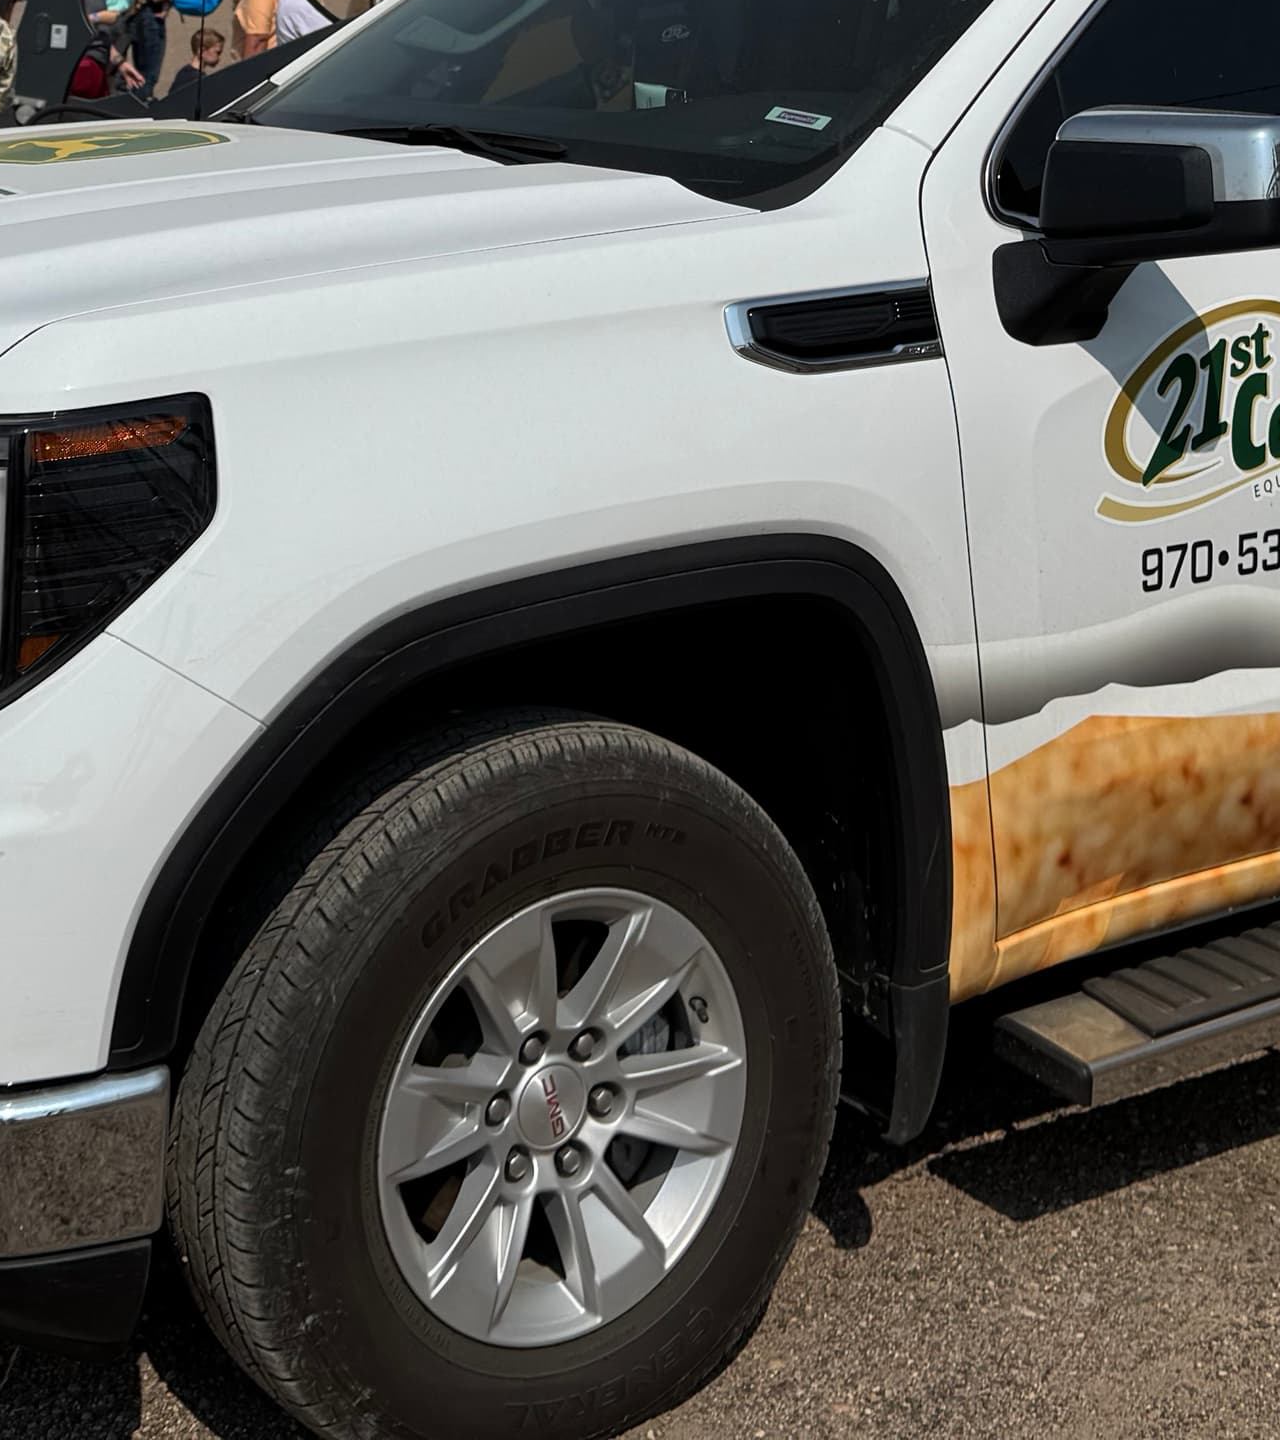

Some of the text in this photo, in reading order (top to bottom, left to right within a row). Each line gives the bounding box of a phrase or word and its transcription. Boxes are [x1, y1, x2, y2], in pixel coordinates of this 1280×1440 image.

[1141, 322, 1273, 488] 21st
[422, 819, 636, 948] GRABBER
[541, 1073, 565, 1138] GMC
